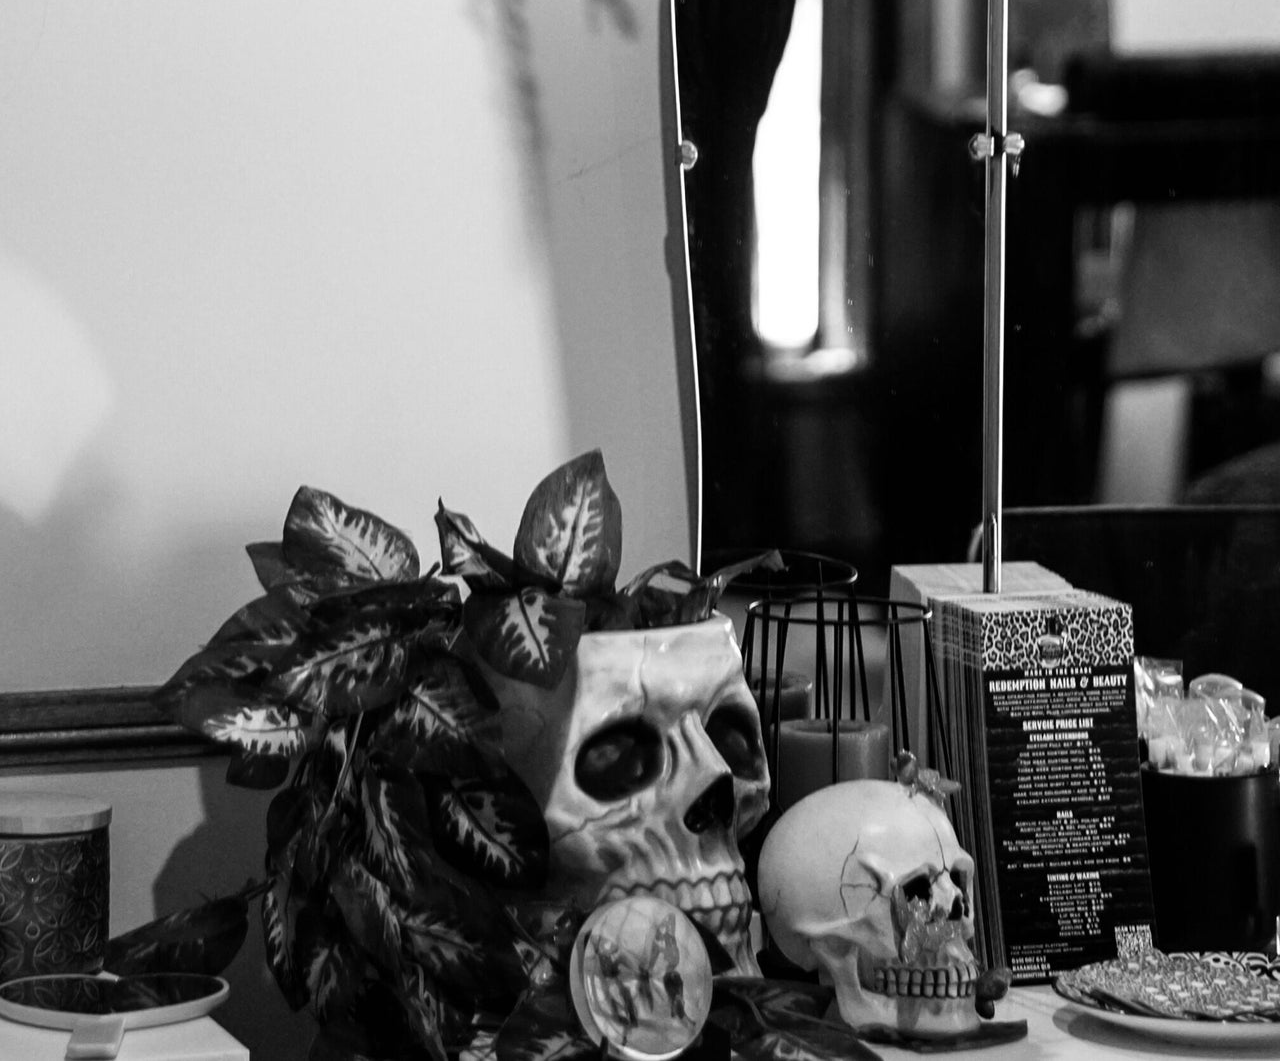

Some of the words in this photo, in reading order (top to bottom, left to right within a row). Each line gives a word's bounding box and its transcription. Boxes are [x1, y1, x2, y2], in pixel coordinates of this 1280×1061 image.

[989, 679, 1046, 693] REDEMPTION
[1049, 677, 1076, 690] NAILS
[1079, 676, 1089, 688] &
[1093, 674, 1127, 687] BEAUTY
[1055, 718, 1078, 730] PRICE
[1078, 717, 1094, 728] LIST
[1029, 733, 1054, 742] EYELASH
[1054, 731, 1089, 740] EXTENSIONS
[1056, 810, 1074, 818] NAILS
